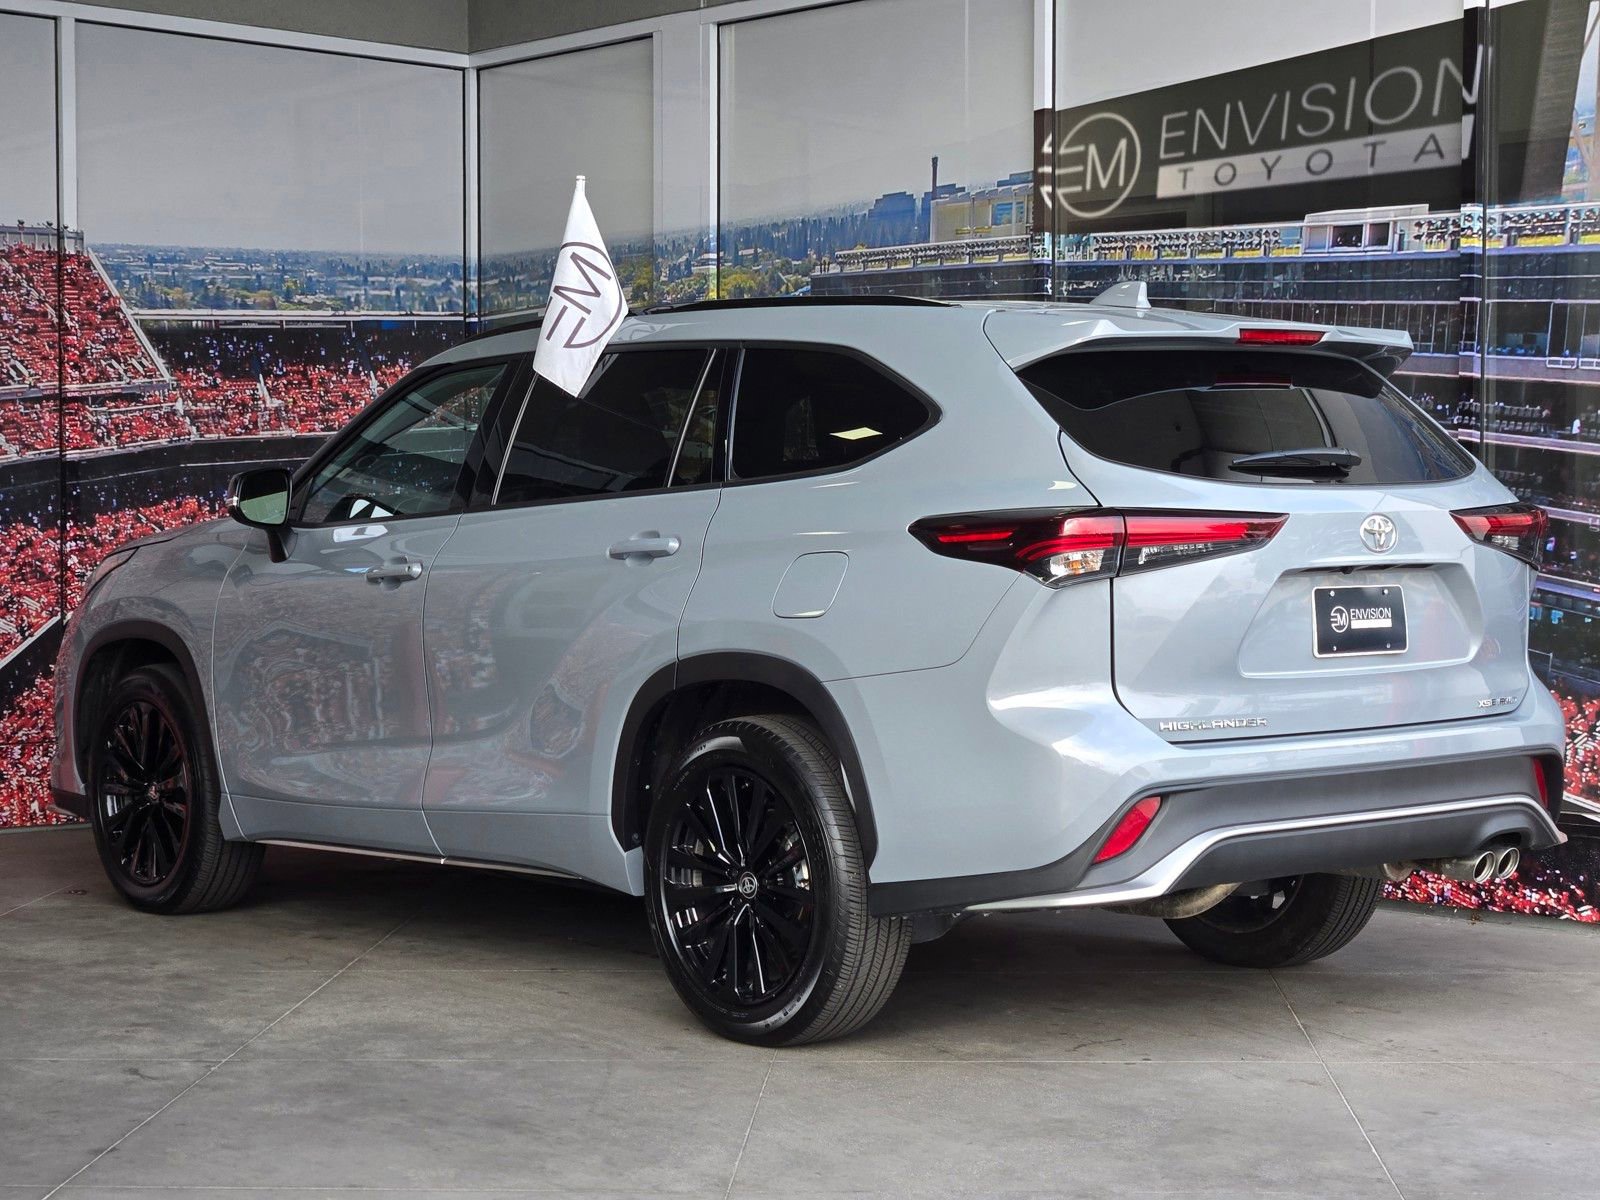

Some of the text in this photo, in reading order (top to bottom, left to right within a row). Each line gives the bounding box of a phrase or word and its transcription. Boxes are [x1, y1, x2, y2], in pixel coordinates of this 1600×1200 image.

[1159, 45, 1486, 159] ENVISION
[1178, 133, 1445, 191] TOYOTA
[1350, 607, 1392, 620] ENVISION
[1159, 717, 1268, 731] HIGHLANDER
